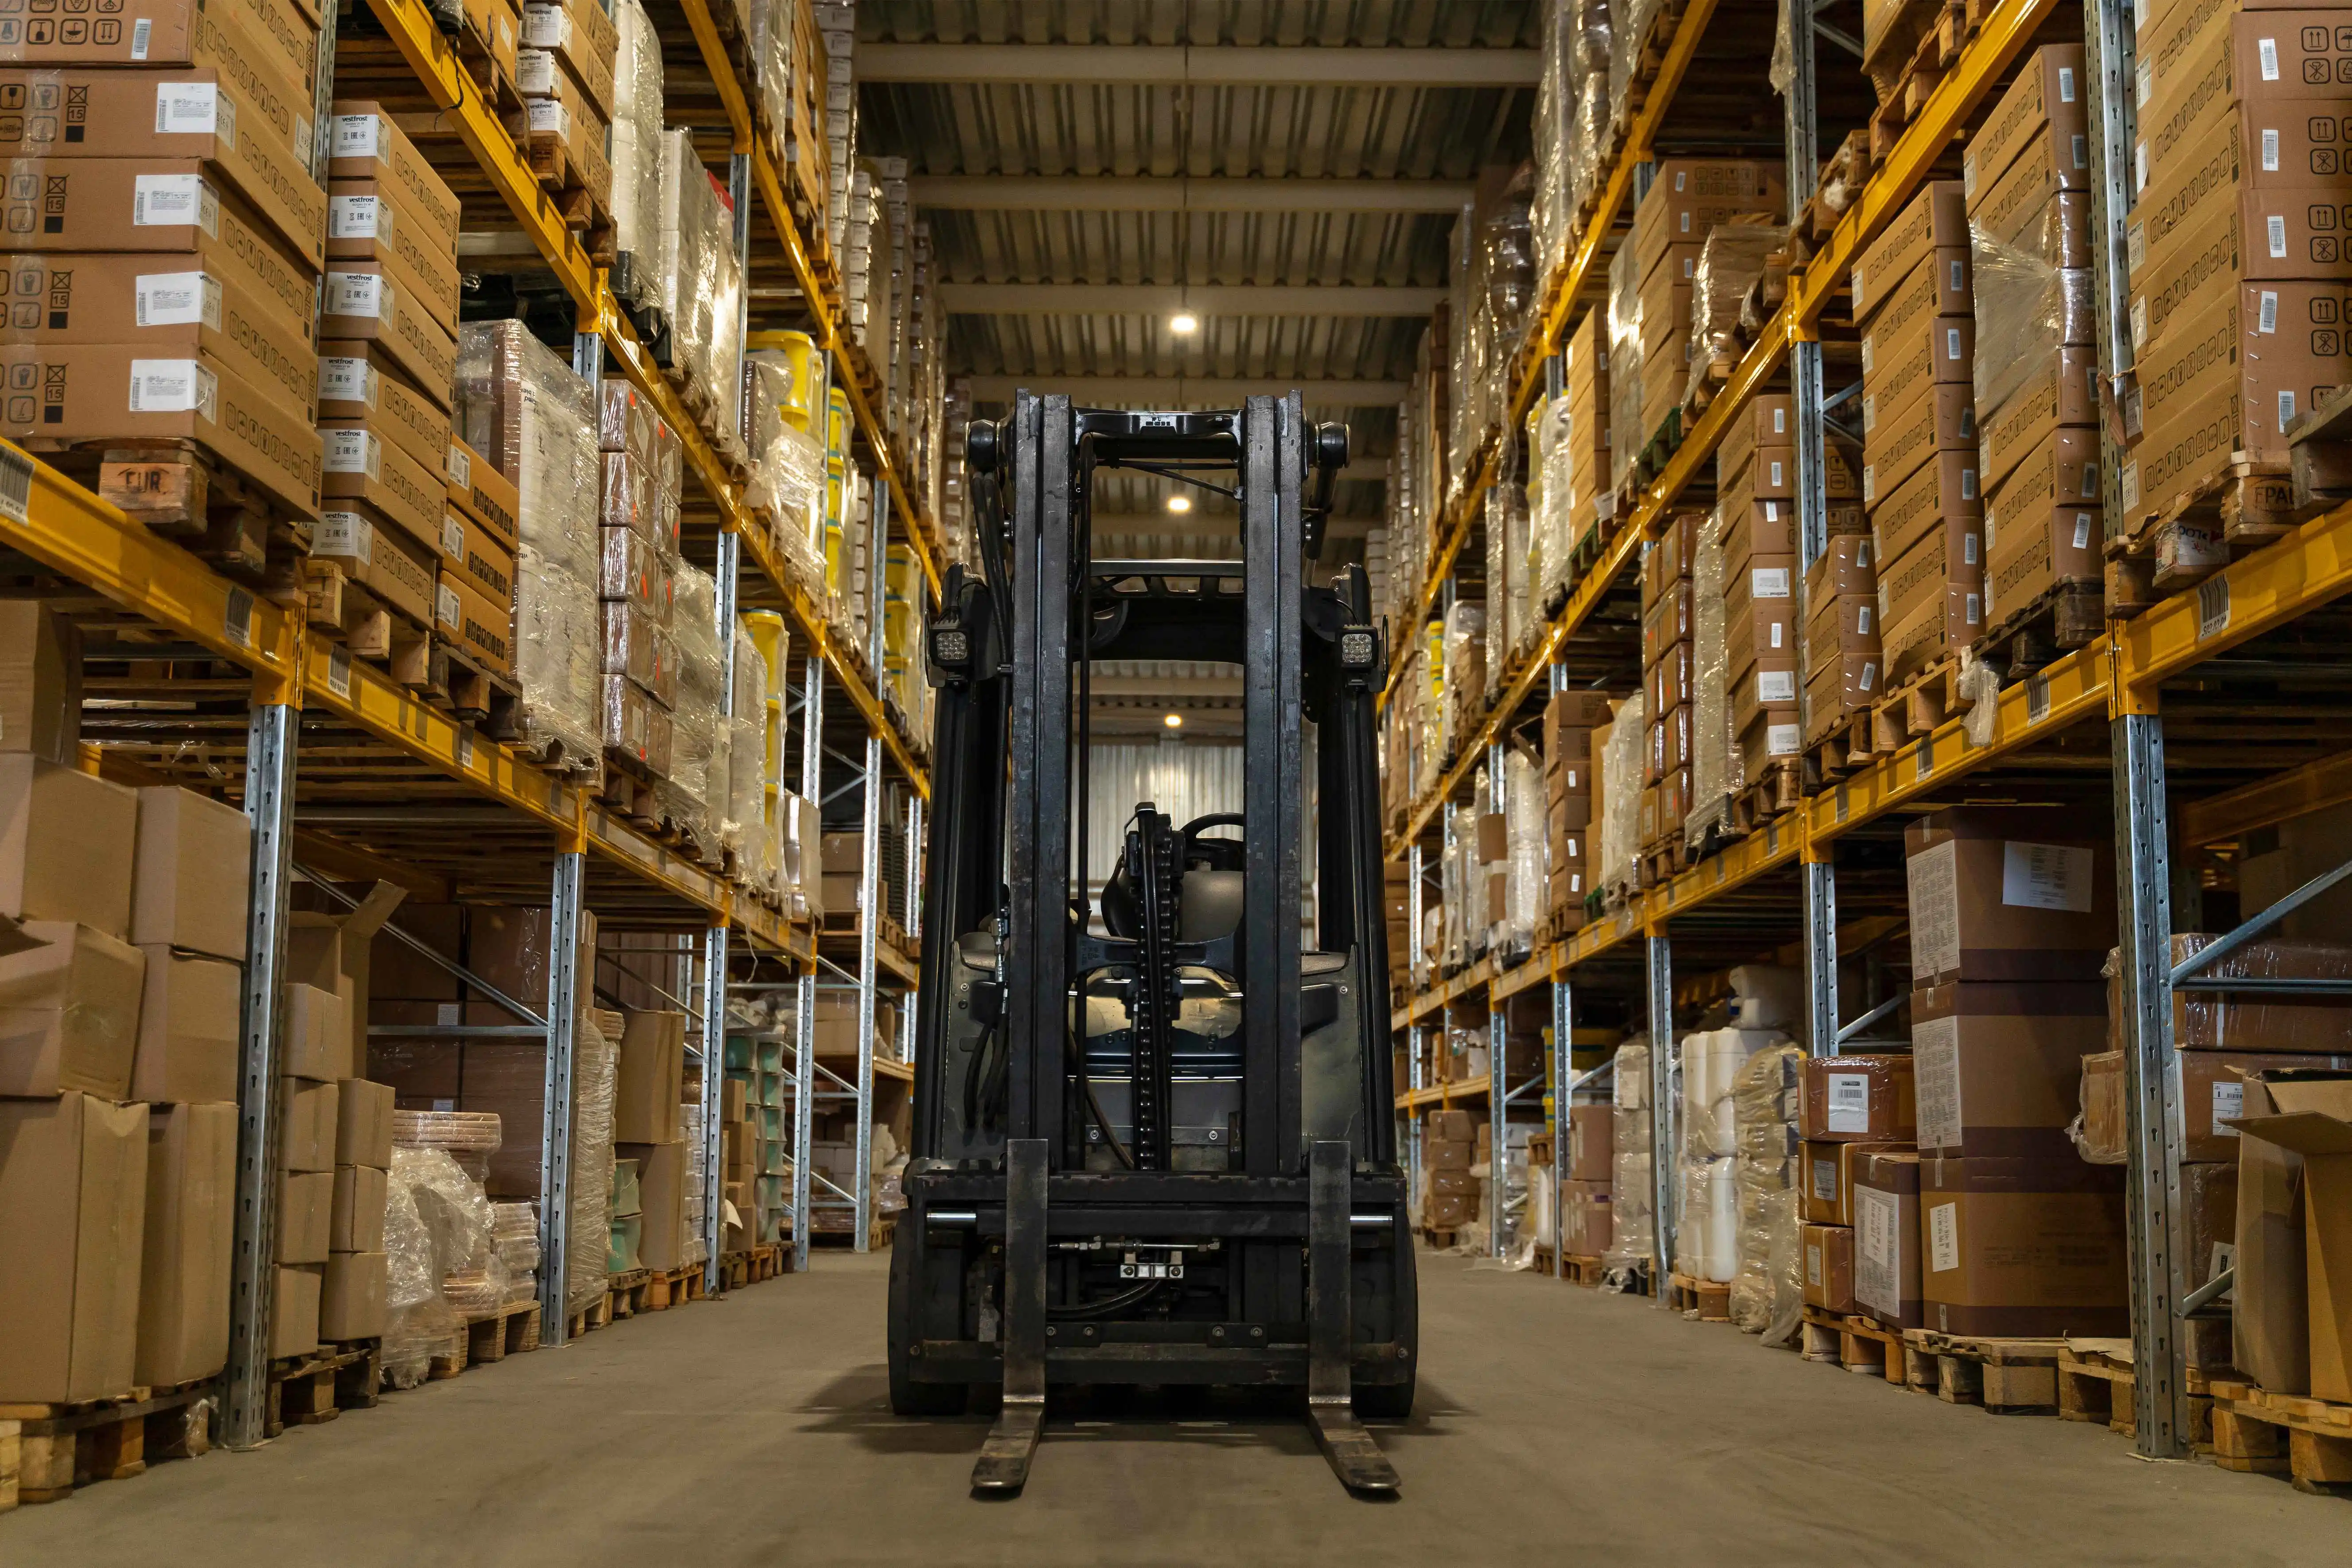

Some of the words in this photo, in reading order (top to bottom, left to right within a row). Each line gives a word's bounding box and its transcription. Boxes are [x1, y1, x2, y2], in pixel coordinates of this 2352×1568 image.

[69, 109, 84, 119] 15
[49, 199, 62, 209] 15
[54, 295, 68, 304] 15
[48, 389, 62, 398] 15
[125, 471, 161, 494] EUR
